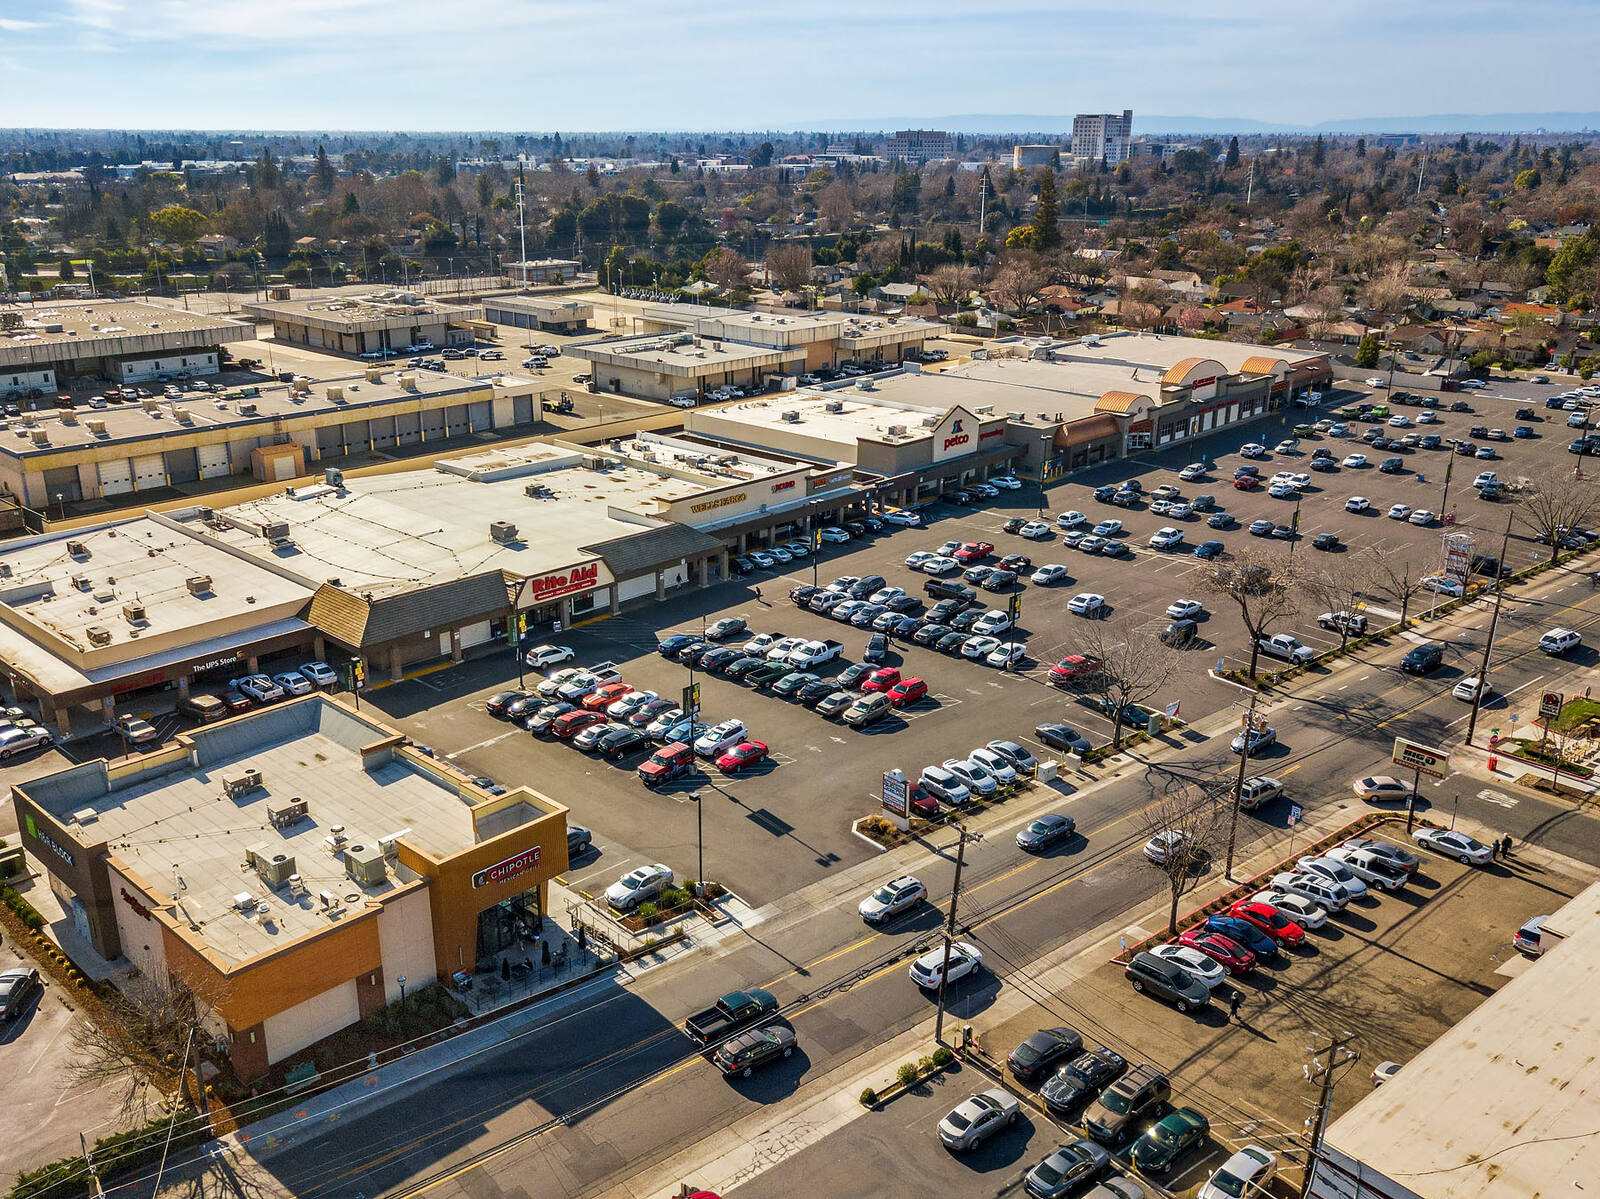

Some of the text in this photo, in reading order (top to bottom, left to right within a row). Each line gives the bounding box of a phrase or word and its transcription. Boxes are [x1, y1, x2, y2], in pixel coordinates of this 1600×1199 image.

[944, 434, 969, 451] petco
[691, 493, 747, 514] WELLS FARGO
[533, 576, 568, 594] Rite
[569, 563, 598, 584] Aid
[193, 656, 237, 672] The UPS Store
[490, 851, 540, 880] CHIPOTLE
[499, 870, 524, 885] MEXICAN
